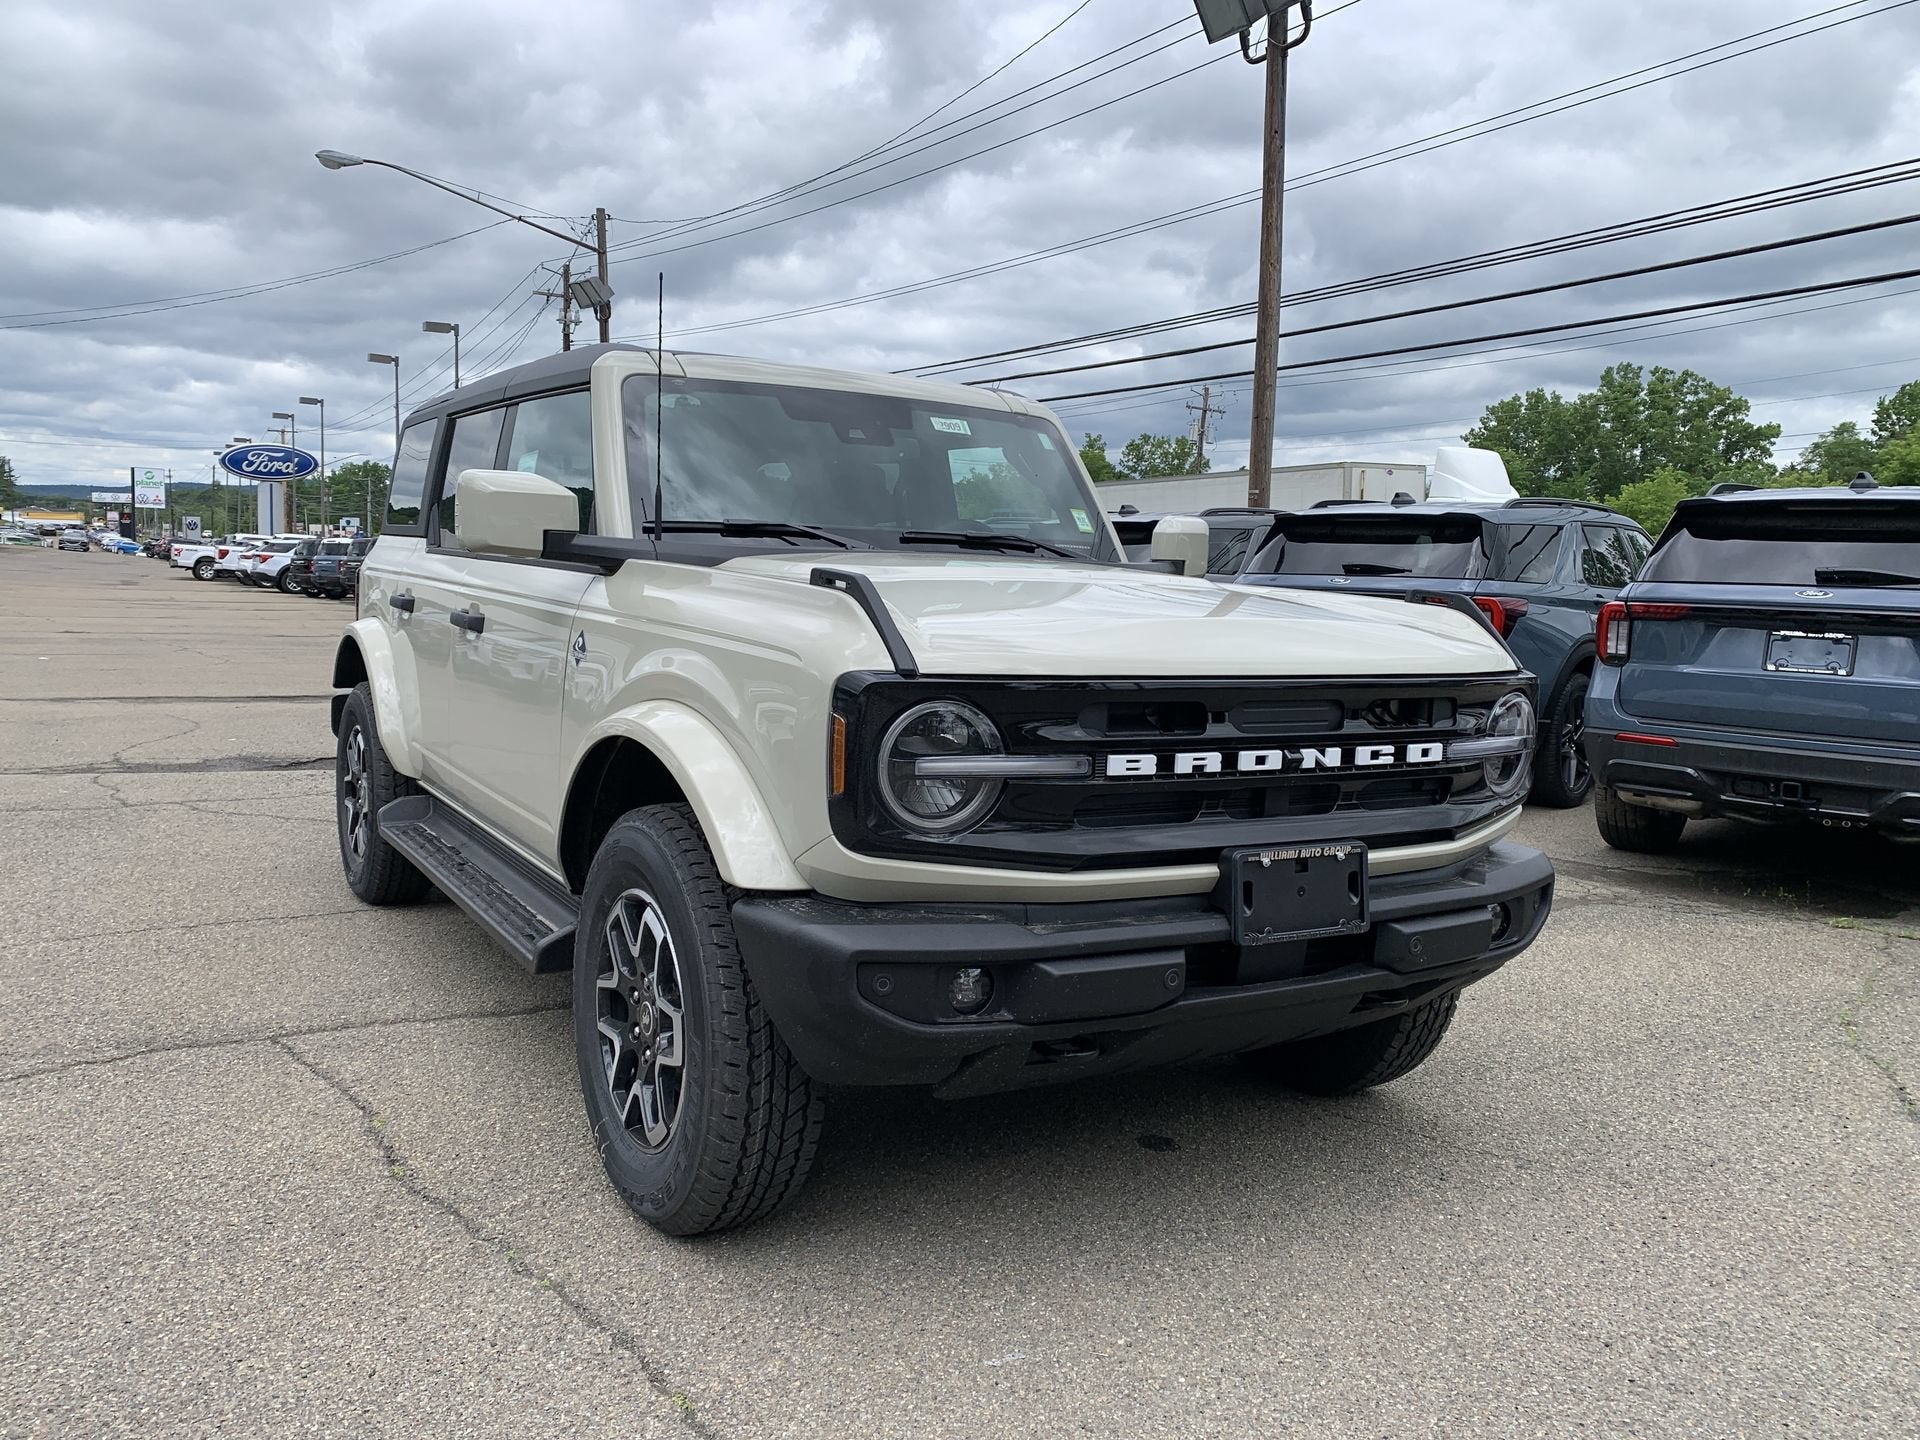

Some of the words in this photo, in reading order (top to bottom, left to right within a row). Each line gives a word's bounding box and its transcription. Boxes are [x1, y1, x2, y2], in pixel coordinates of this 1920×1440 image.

[241, 450, 299, 473] Ford
[135, 479, 164, 487] planet
[1106, 742, 1444, 777] BRONCO
[1300, 847, 1322, 858] AUTO
